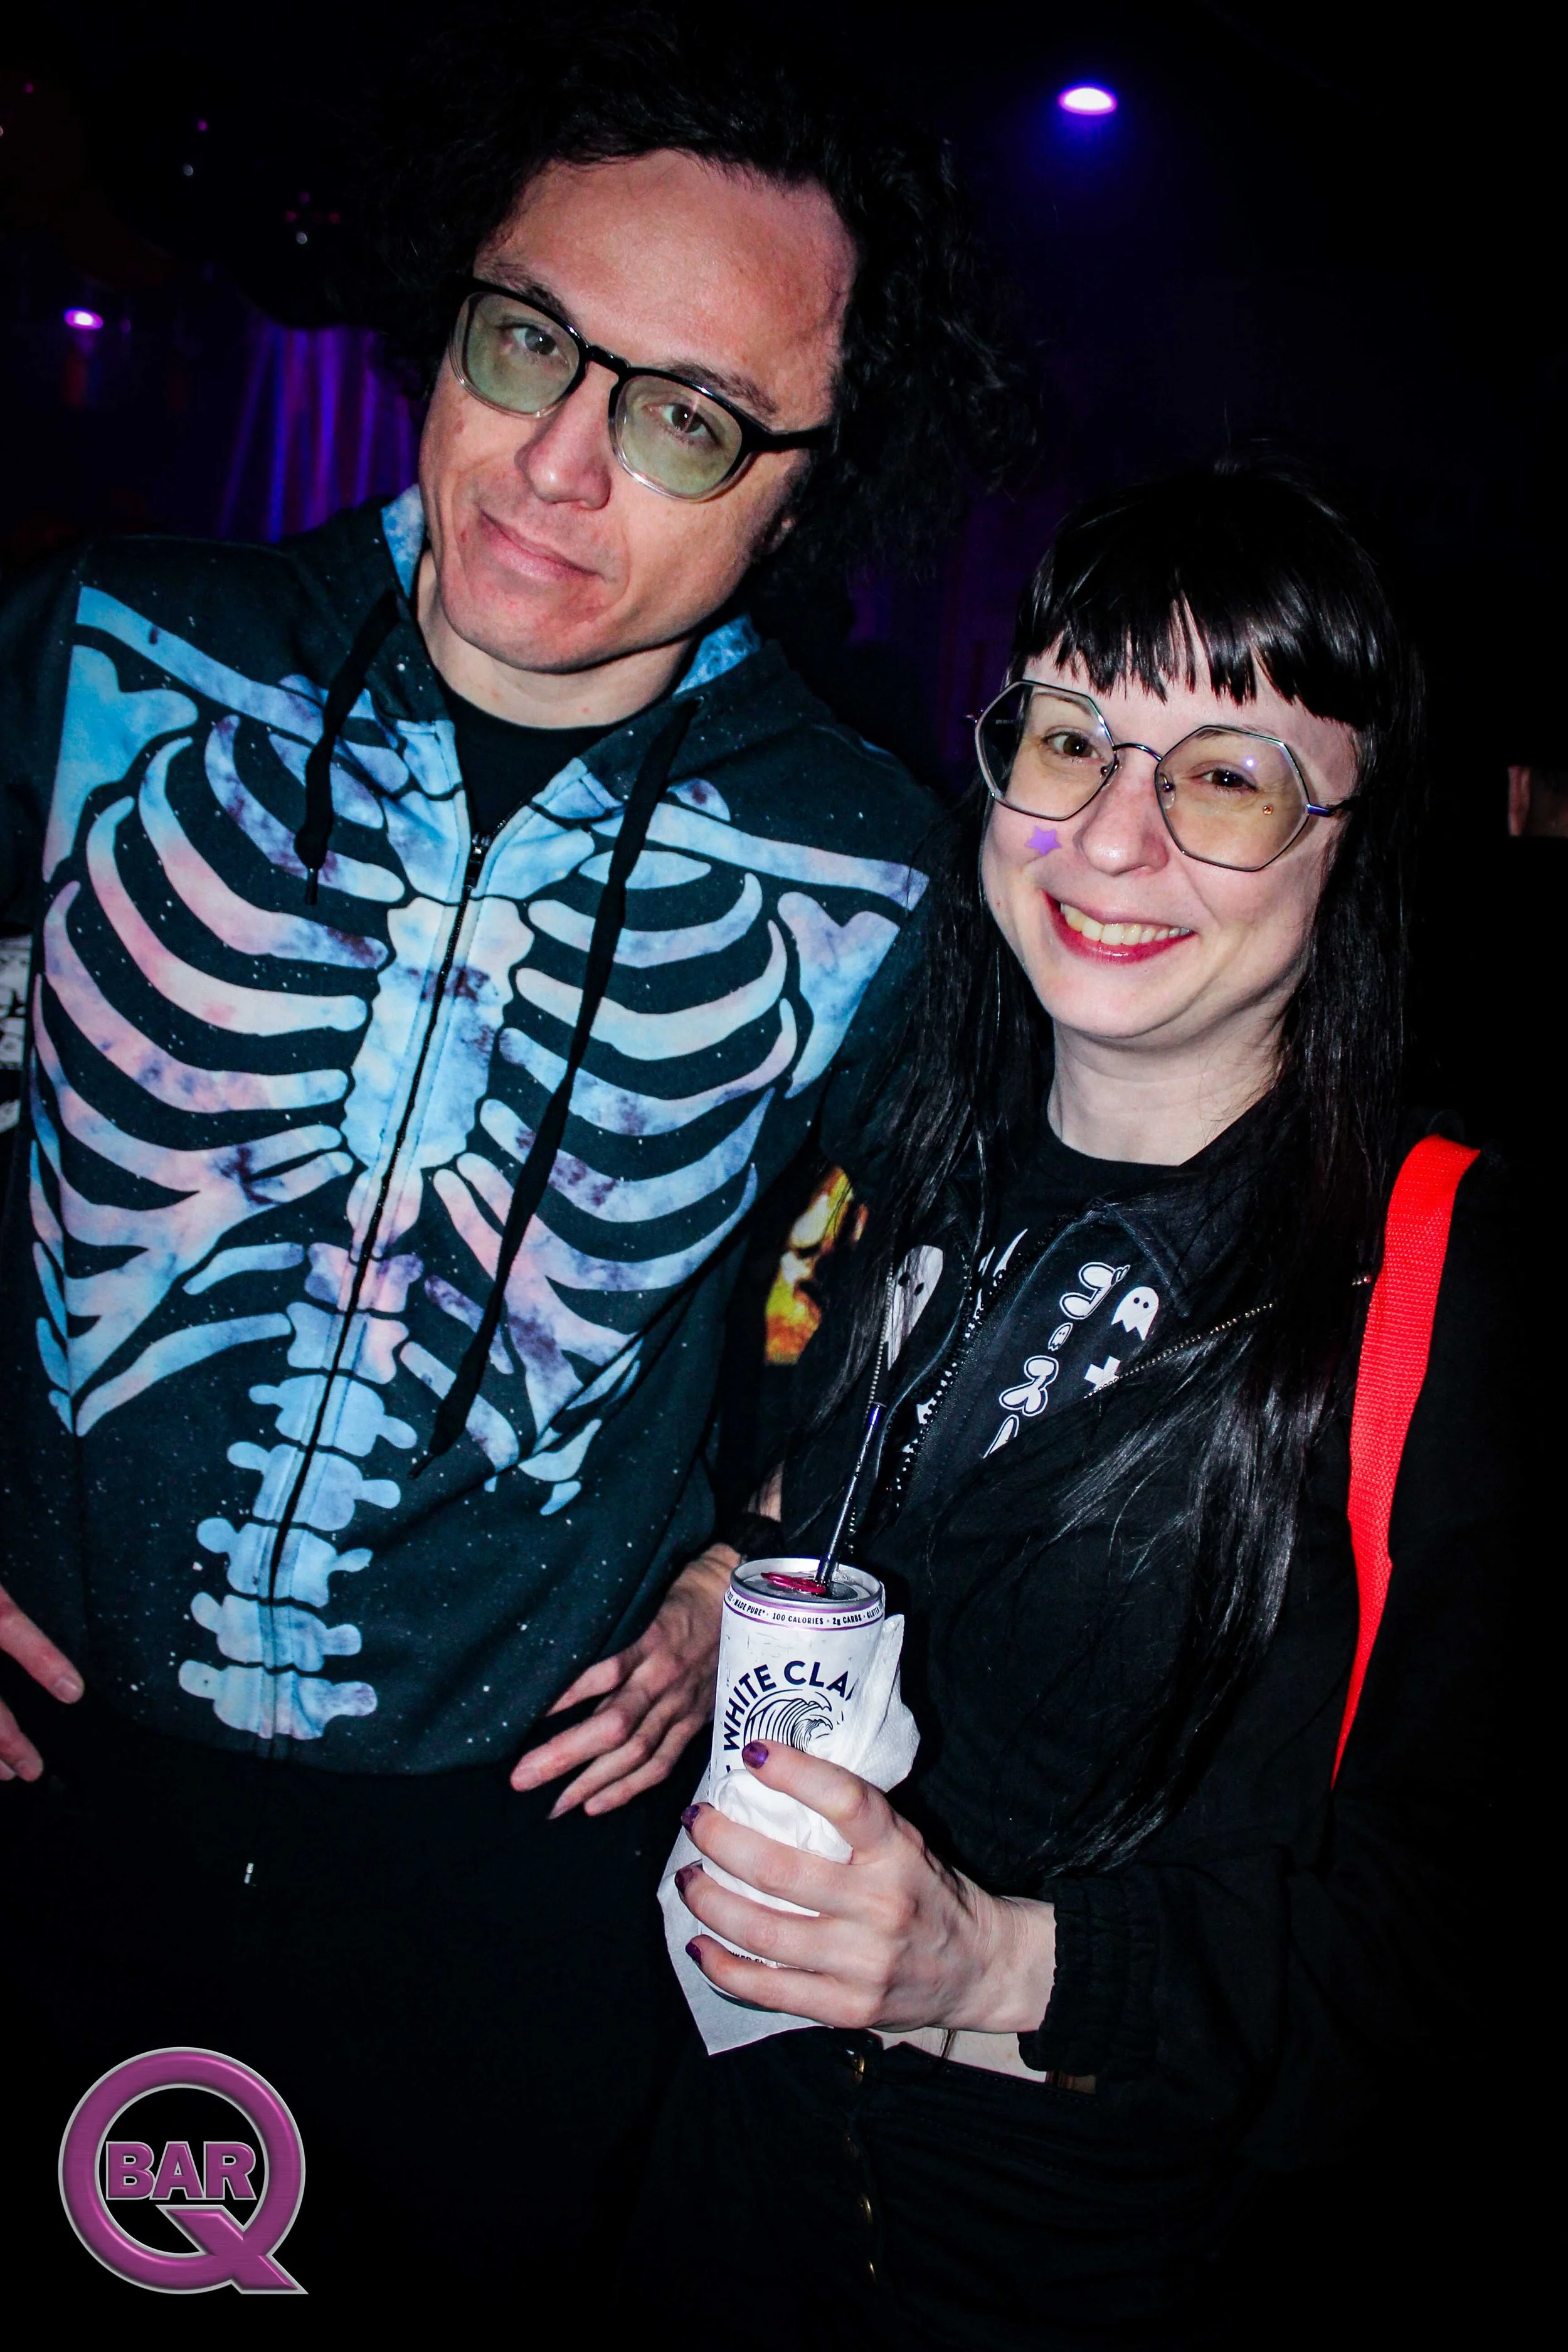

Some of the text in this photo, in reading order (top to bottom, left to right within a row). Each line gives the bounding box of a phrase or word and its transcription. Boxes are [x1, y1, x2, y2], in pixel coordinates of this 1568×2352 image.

[734, 1599, 747, 1611] MADE
[773, 1613, 785, 1621] 100
[788, 1616, 824, 1624] CALORIES
[832, 1618, 841, 1626] 2g
[842, 1614, 862, 1624] CARBS
[724, 1664, 777, 1751] WHITE
